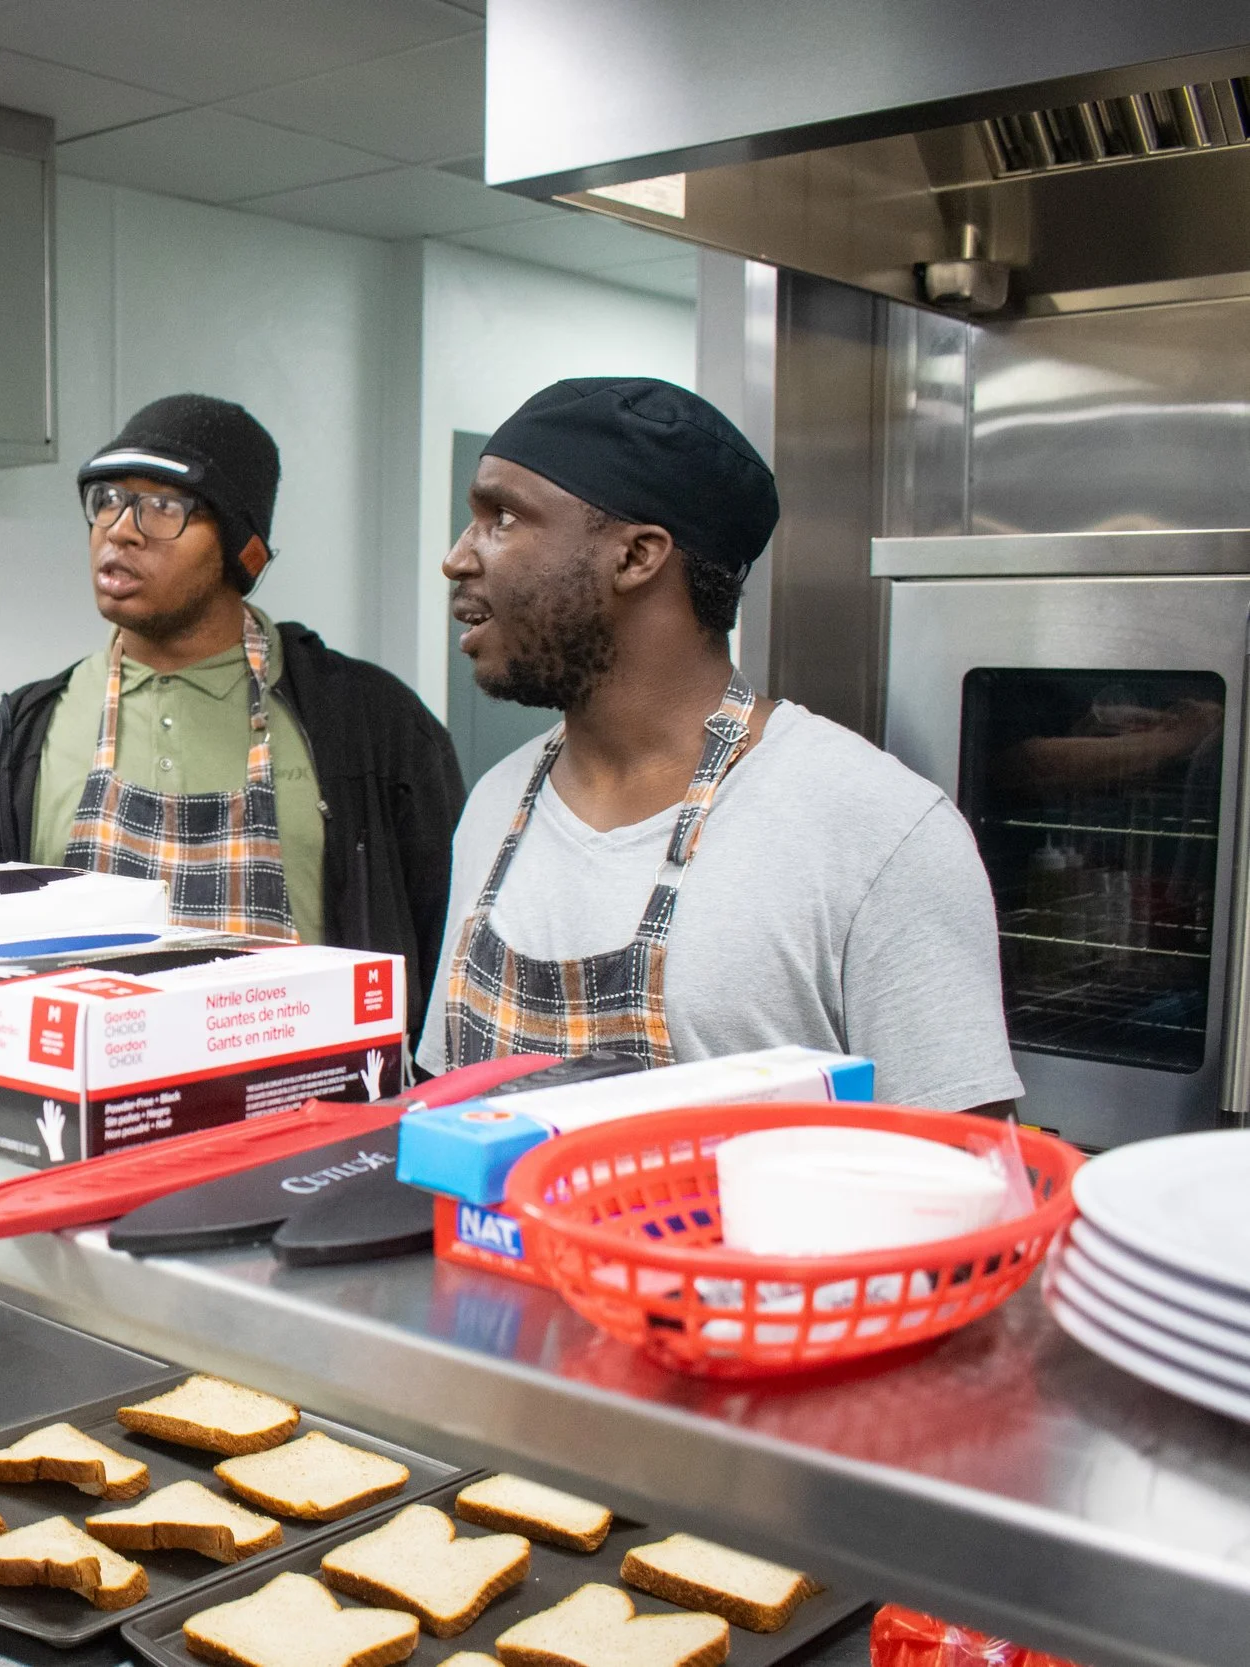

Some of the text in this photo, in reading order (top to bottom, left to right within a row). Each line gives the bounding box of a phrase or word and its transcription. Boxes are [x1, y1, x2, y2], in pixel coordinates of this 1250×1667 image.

[368, 968, 379, 984] M
[206, 986, 287, 1010] Nitrile Gloves
[47, 1005, 62, 1024] M
[104, 1008, 146, 1024] Gordon
[206, 1000, 311, 1031] Guantes de nitrilo
[104, 1039, 147, 1056] Gordon
[207, 1023, 296, 1052] Gants en nitrile
[461, 1206, 519, 1256] NAT
